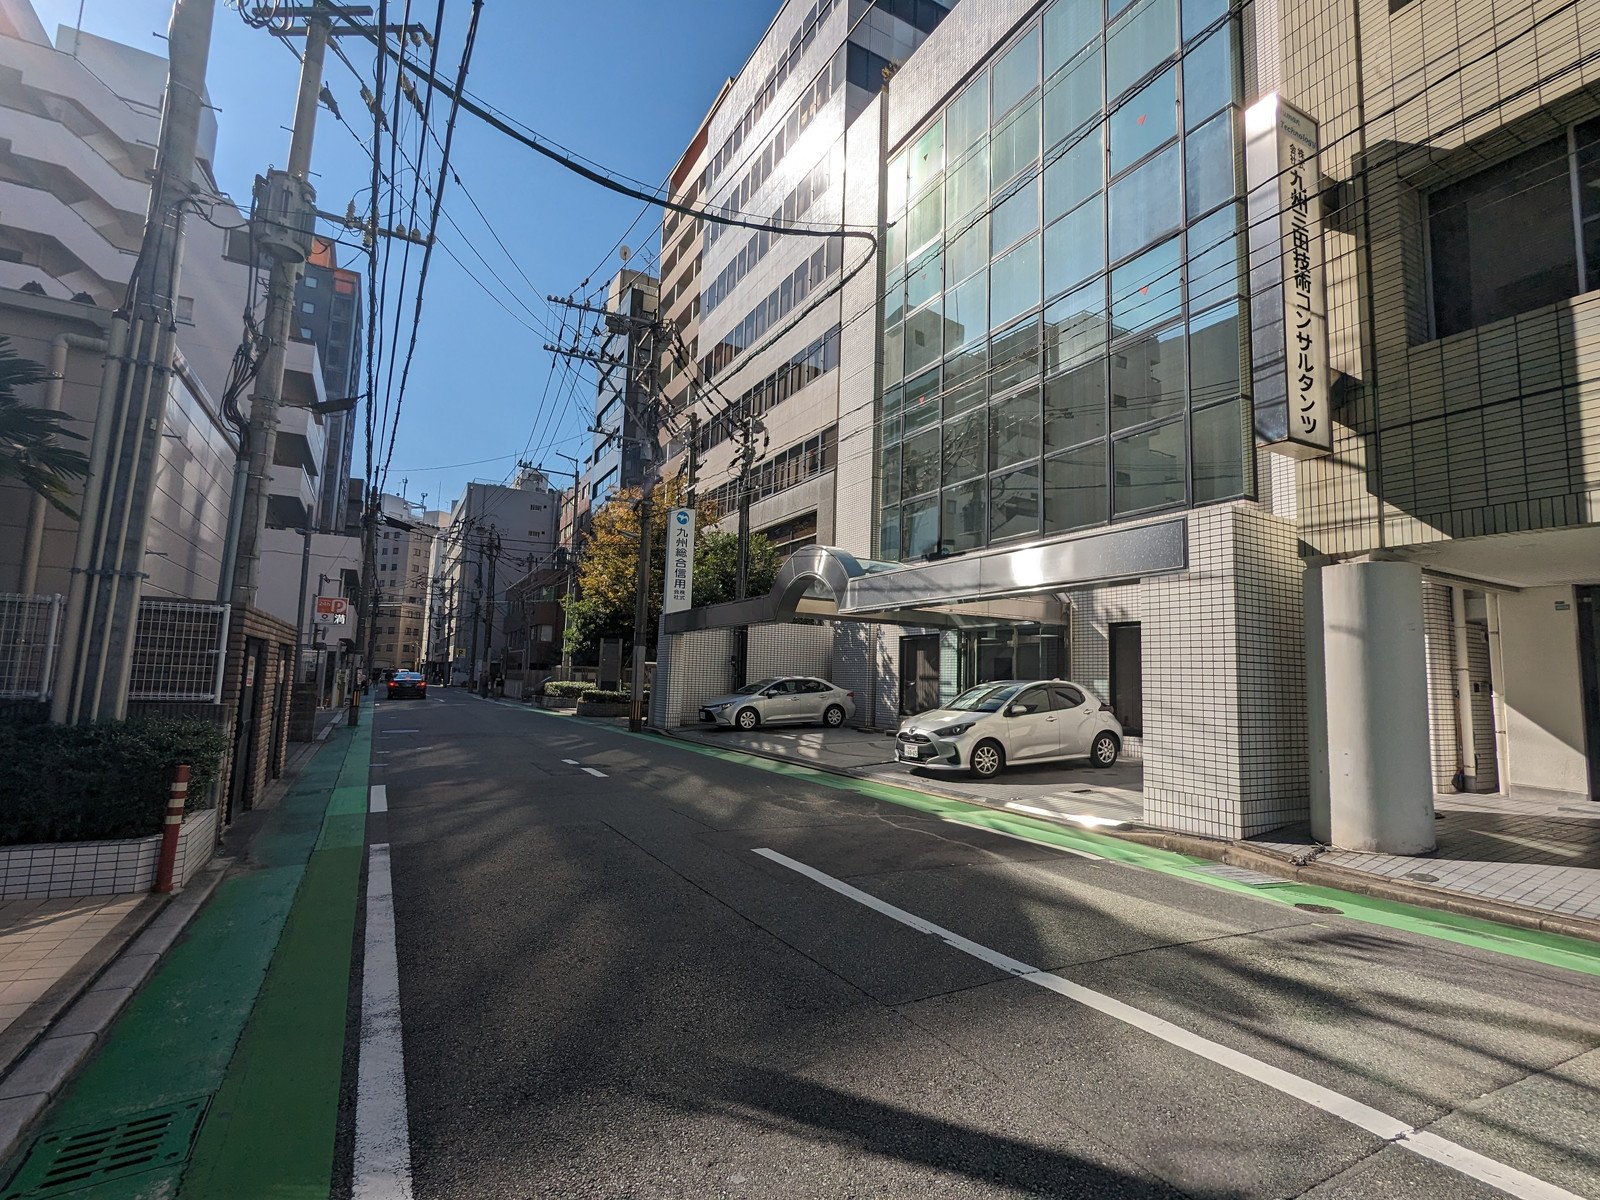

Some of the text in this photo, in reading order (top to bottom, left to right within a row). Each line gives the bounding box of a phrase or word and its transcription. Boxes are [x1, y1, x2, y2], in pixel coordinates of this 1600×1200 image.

[1280, 121, 1317, 149] Technology
[1290, 169, 1316, 434] 九州三田技術コンサルタンツ
[674, 527, 688, 589] 九州総合信用
[331, 600, 347, 613] P
[333, 613, 346, 624] 満
